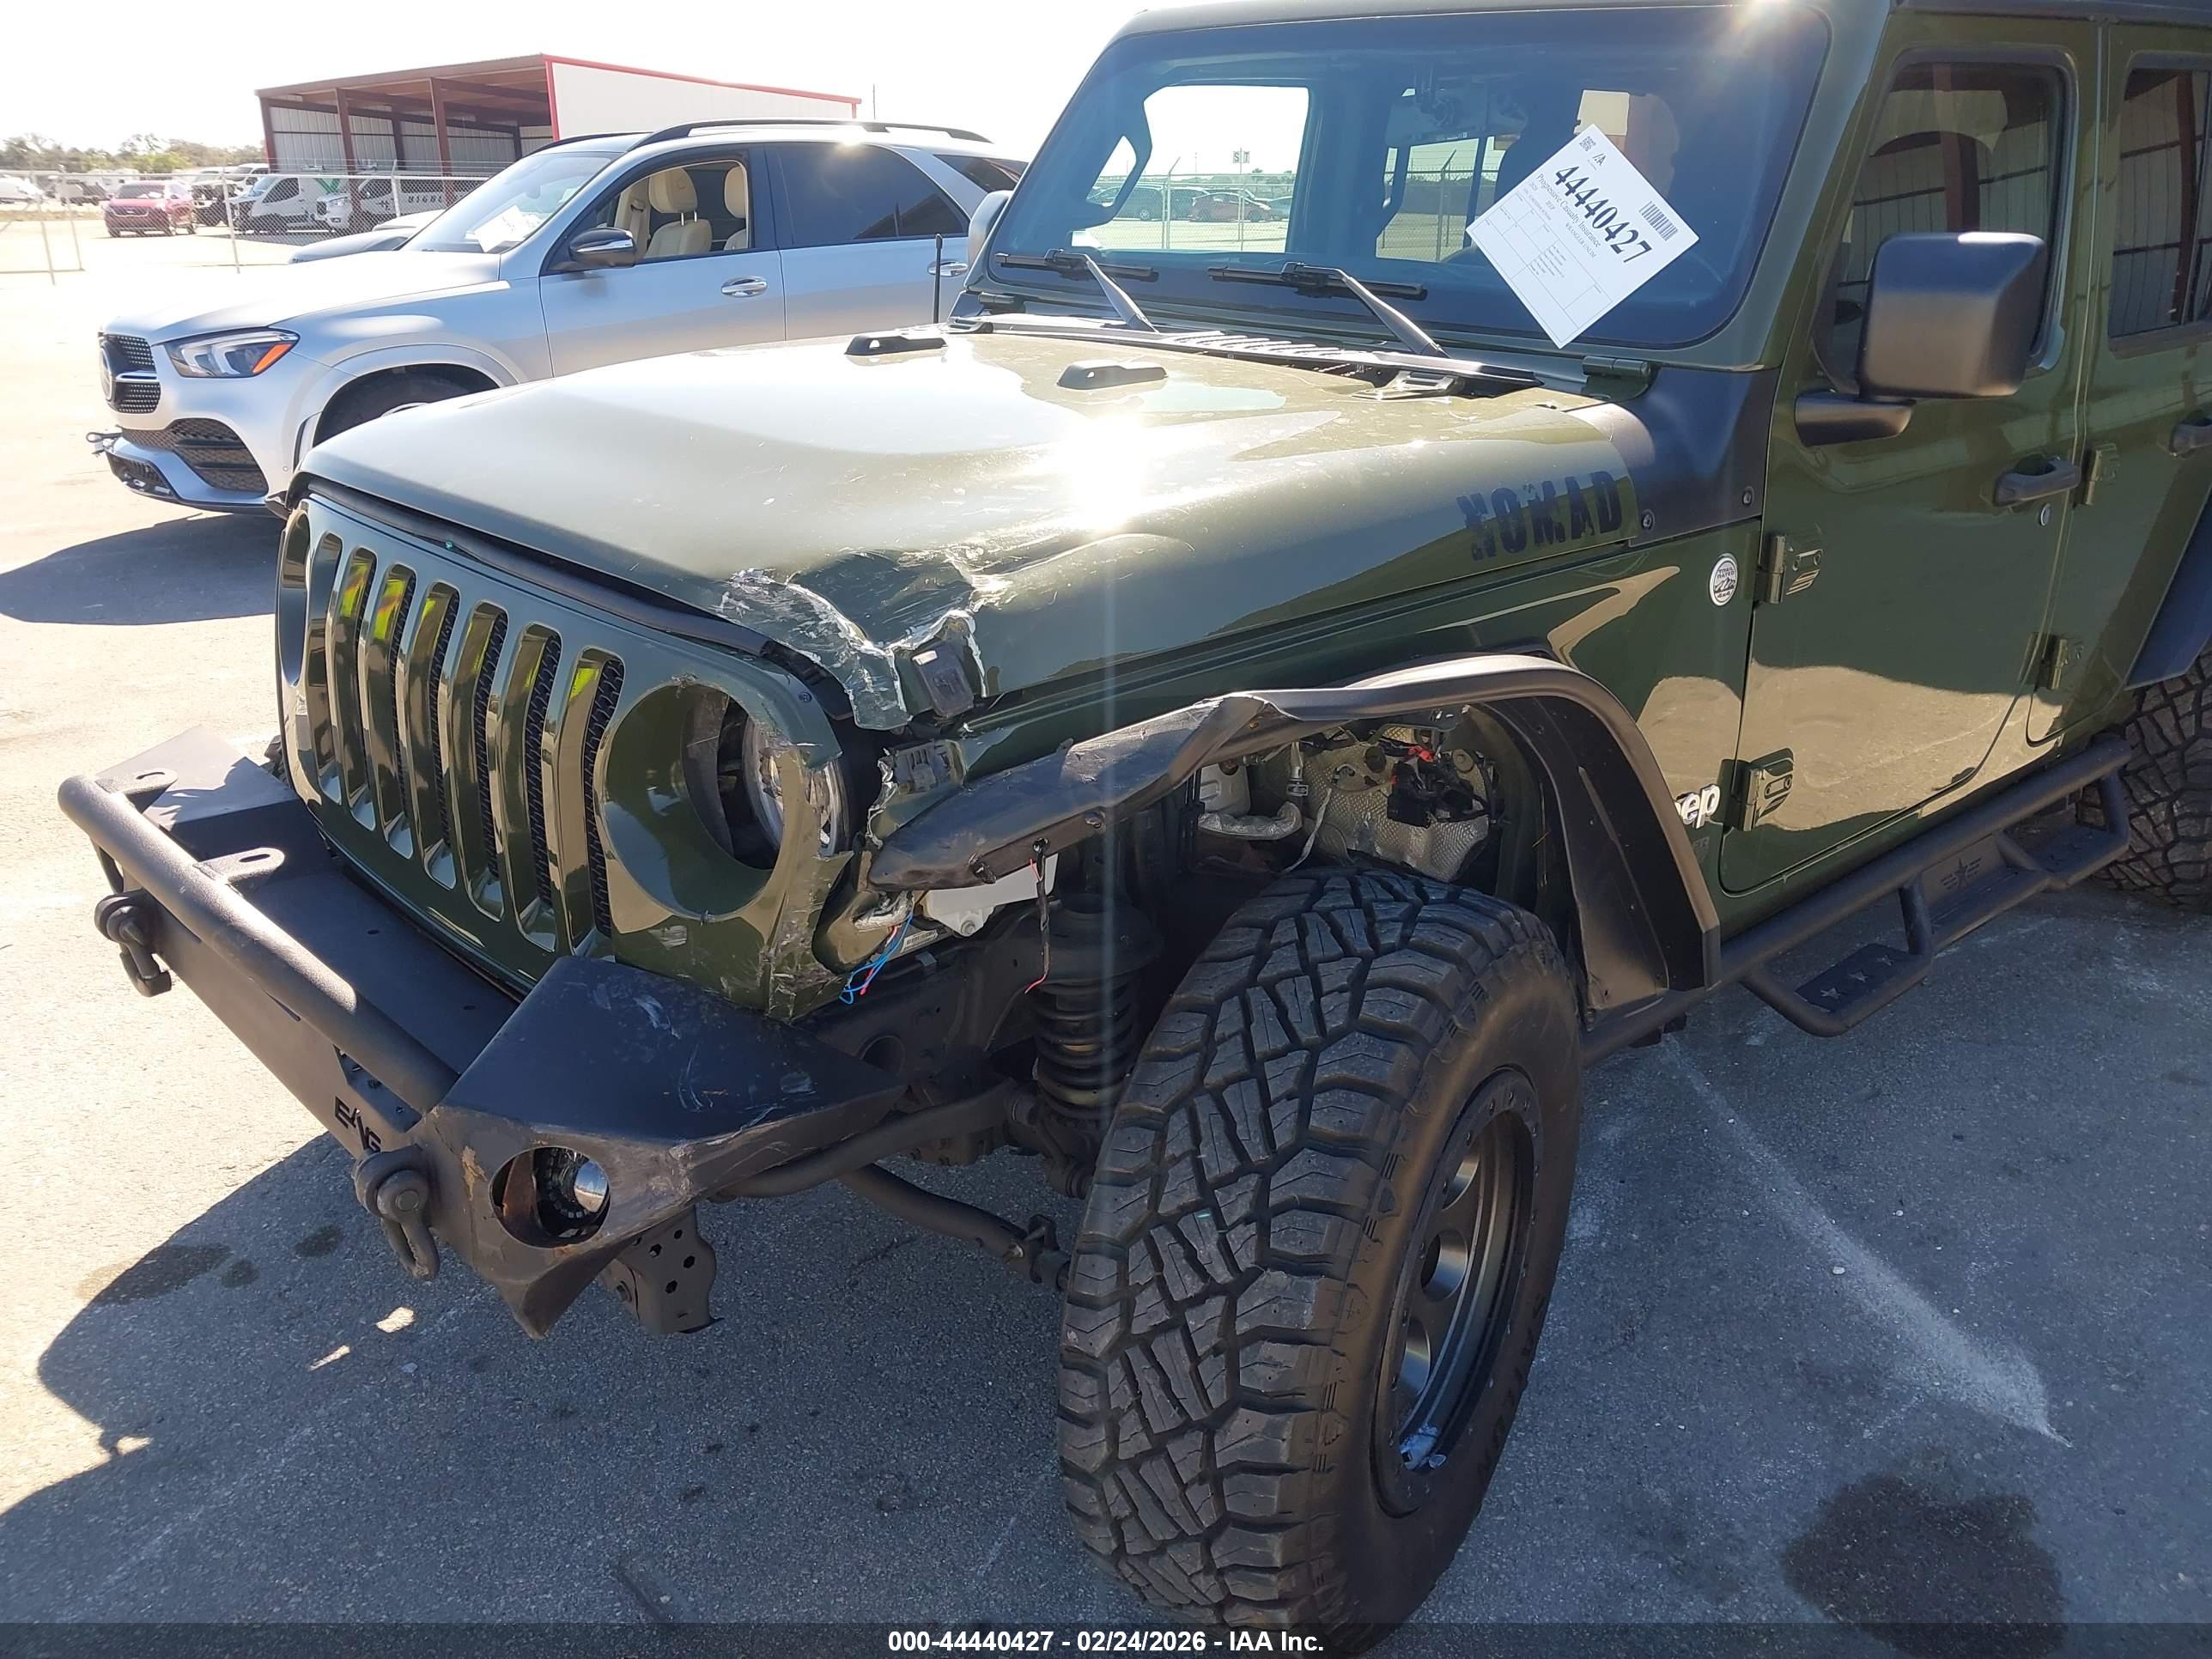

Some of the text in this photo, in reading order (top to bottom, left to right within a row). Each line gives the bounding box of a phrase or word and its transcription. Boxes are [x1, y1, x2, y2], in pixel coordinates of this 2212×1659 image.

[1536, 173, 1562, 202] Progressive
[1560, 200, 1579, 224] Casualty
[1578, 221, 1601, 247] Insurance
[1555, 166, 1652, 263] 44440427
[1456, 471, 1622, 560] NOMAD
[1674, 783, 1720, 830] ep
